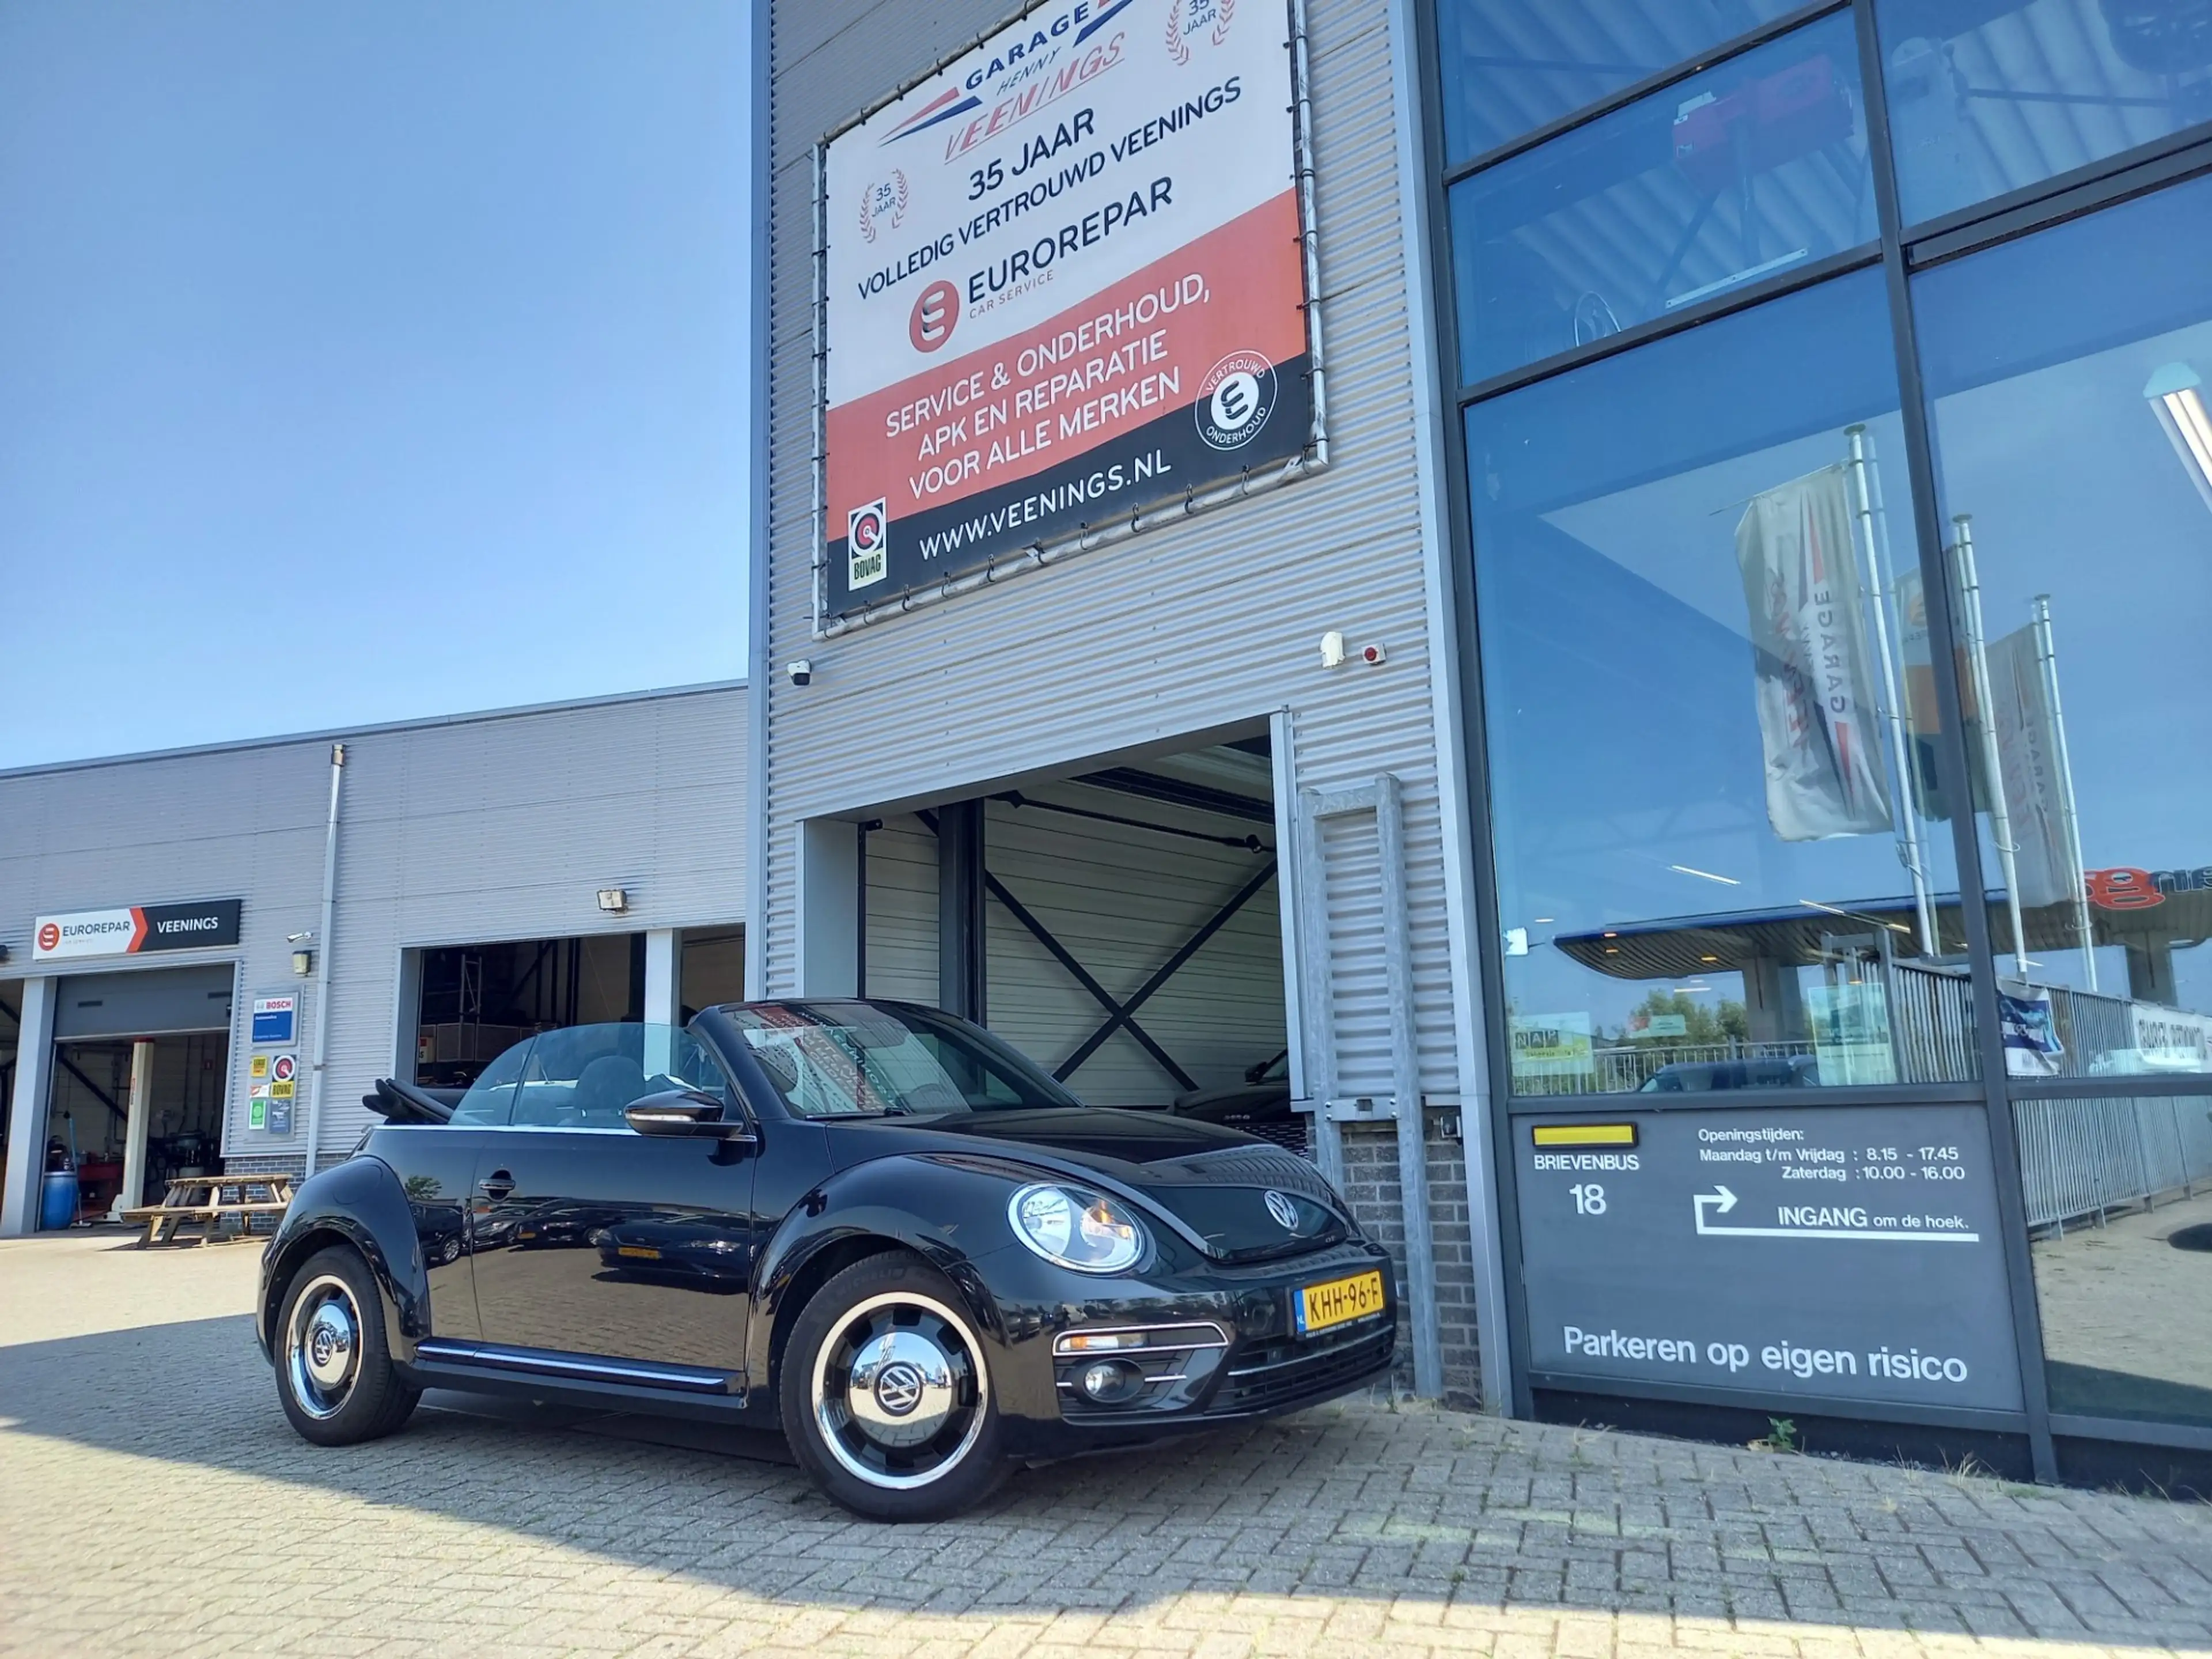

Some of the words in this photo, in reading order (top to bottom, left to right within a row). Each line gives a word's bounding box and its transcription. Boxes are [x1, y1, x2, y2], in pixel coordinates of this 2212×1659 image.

[1183, 8, 1217, 35] JAAR
[965, 2, 1090, 90] GARAGE
[997, 46, 1062, 96] HENNY
[945, 31, 1125, 161] VEENINGS
[968, 159, 1003, 200] 35
[1012, 108, 1094, 176] JAAR
[858, 233, 955, 300] VOLLEDIG
[959, 151, 1105, 247] VERTROUWD
[1110, 75, 1242, 162] VEENINGS
[876, 182, 892, 202] 35
[872, 196, 896, 218] JAAR
[968, 176, 1173, 304] EUROREPAR
[969, 302, 995, 320] CAR
[999, 270, 1055, 310] SERVICE
[885, 376, 983, 438] SERVICE
[991, 365, 1009, 392] &
[1017, 272, 1210, 378] ONDERHOUD,
[1205, 358, 1266, 392] VERTROUWD
[918, 413, 967, 461] APK
[975, 403, 1007, 438] EN
[1016, 328, 1169, 420] REPARATIE
[909, 449, 980, 500] VOOR
[987, 419, 1052, 472] ALLE
[1059, 366, 1181, 441] MERKEN
[1206, 407, 1267, 444] ONDERHOUD
[919, 449, 1172, 562] WWW.VEENINGS.NL
[854, 554, 881, 581] BOVAG
[62, 921, 131, 937] EUROREPAR
[156, 916, 219, 934] VEENINGS
[266, 1001, 291, 1010] BOSCH
[1698, 1127, 1805, 1145] Openingstijden:
[1534, 1154, 1639, 1171] BRIEVENBUS
[1699, 1148, 1762, 1164] Maandag
[1766, 1146, 1793, 1162] t/m
[1796, 1147, 1846, 1164] Vrijdag
[1866, 1146, 1898, 1161] 8.15
[1918, 1146, 1959, 1161] 17.45
[1781, 1165, 1847, 1182] Zaterdag
[1862, 1166, 1906, 1180] 10.00
[1921, 1166, 1965, 1180] 16.00
[1569, 1184, 1607, 1215] 18
[1778, 1206, 1868, 1228] INGANG
[1873, 1217, 1899, 1228] om
[1902, 1213, 1920, 1228] de
[1925, 1214, 1970, 1230] hoek.
[1309, 1277, 1378, 1323] KHH-96-F
[1563, 1325, 1697, 1363] Parkeren
[1706, 1342, 1750, 1373] op
[1760, 1339, 1858, 1378] eigen
[1868, 1346, 1968, 1382] risico
